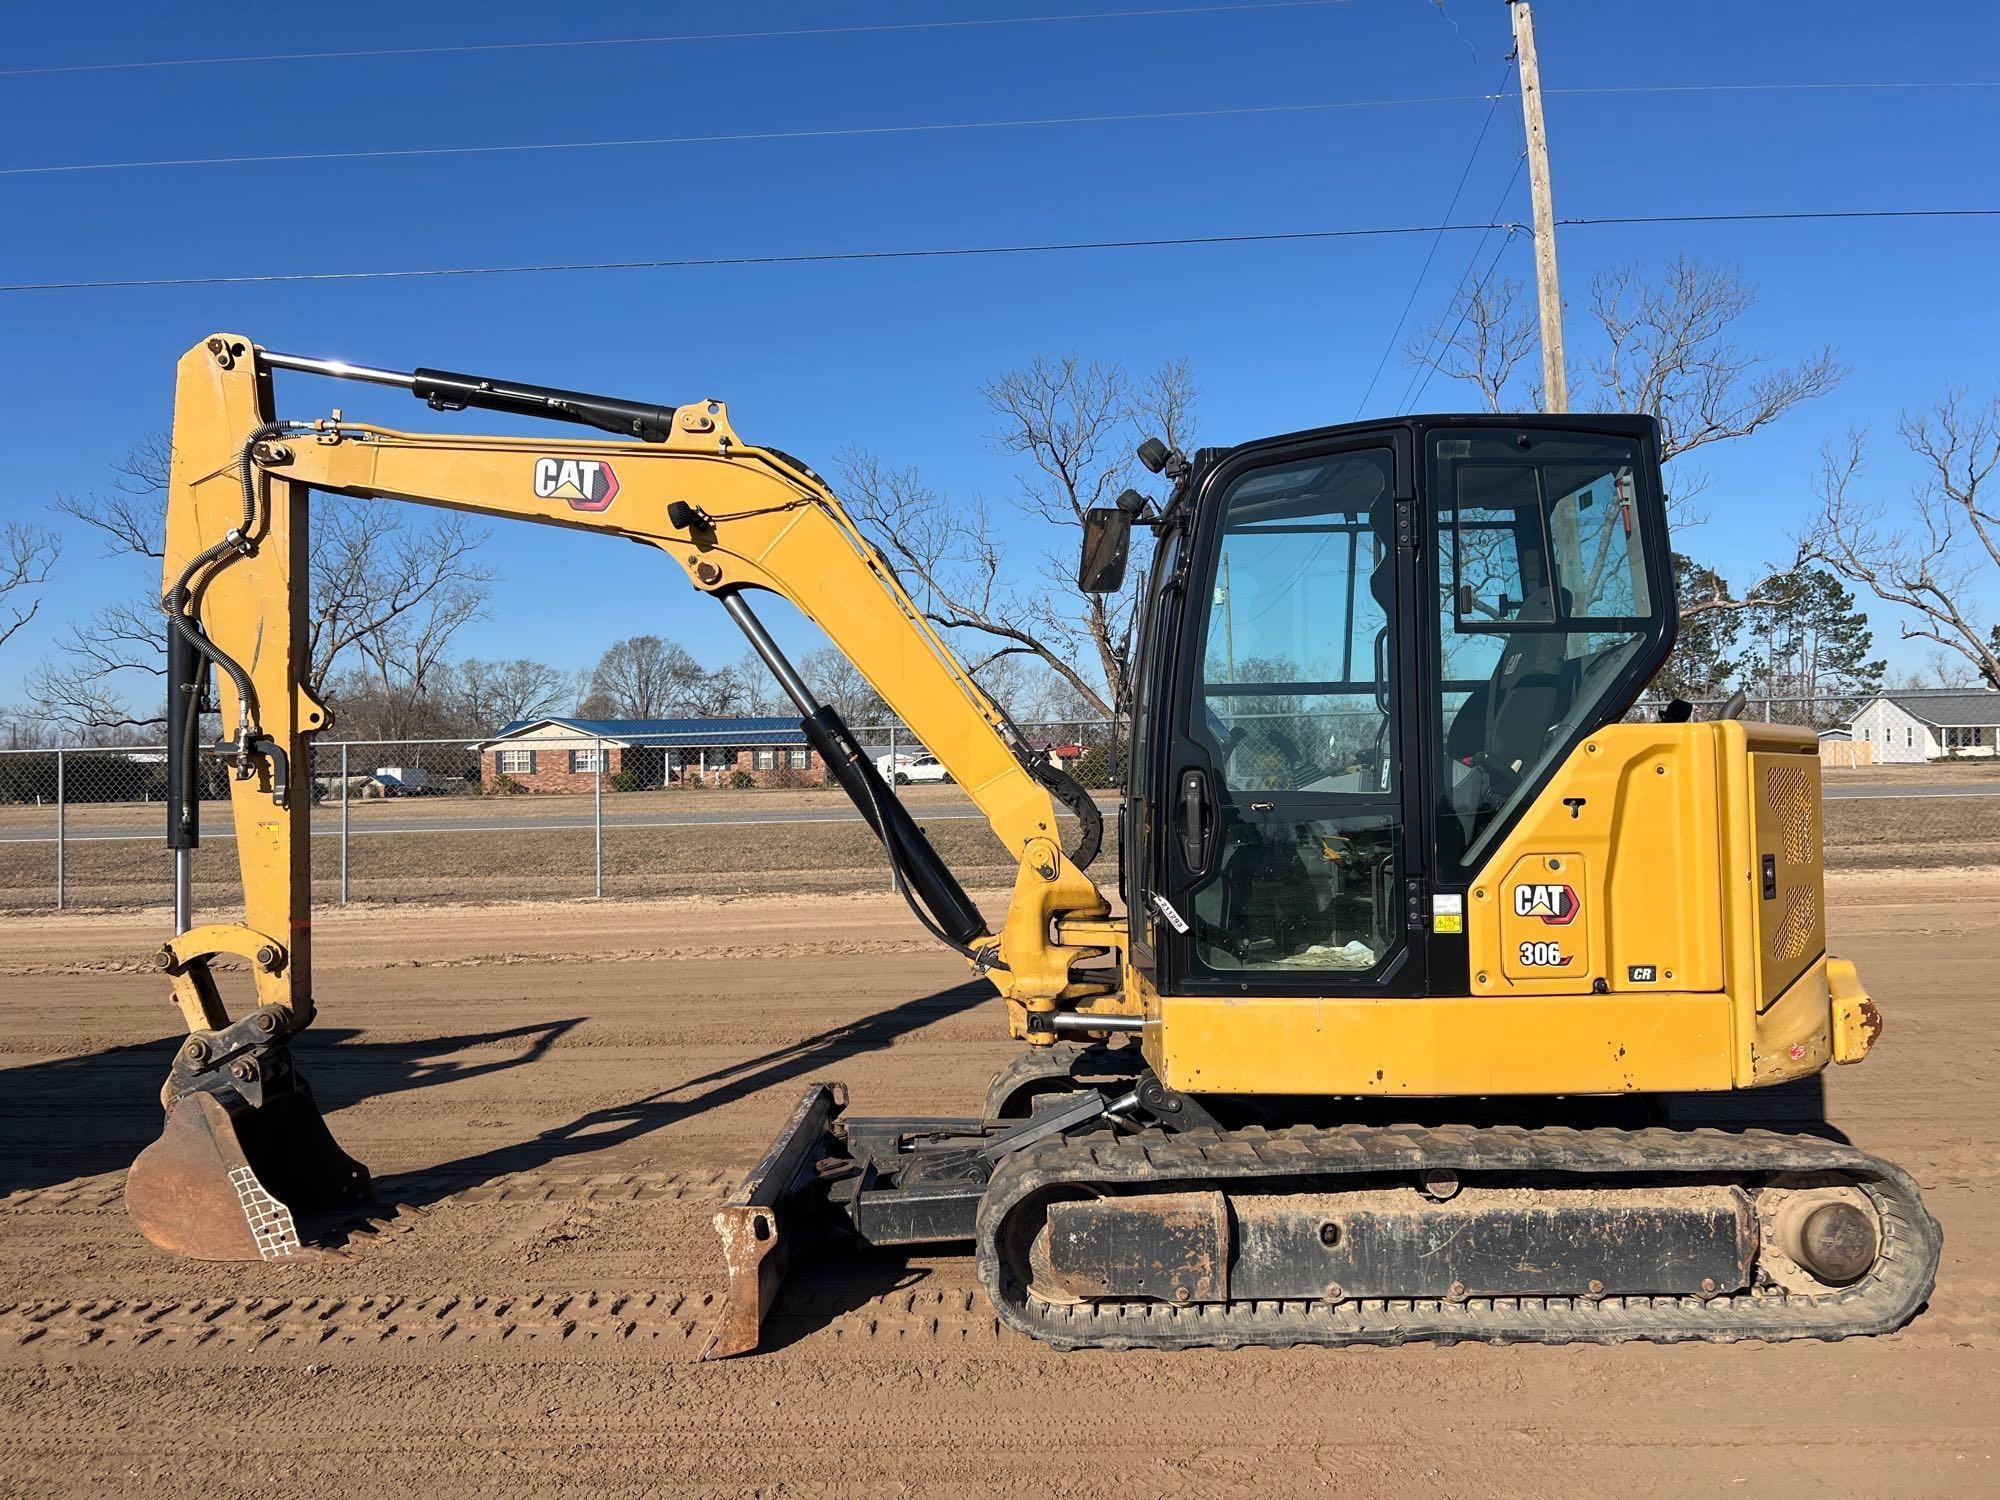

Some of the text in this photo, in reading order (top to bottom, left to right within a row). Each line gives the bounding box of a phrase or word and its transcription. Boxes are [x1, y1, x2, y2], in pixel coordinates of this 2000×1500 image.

[534, 458, 600, 500] CAT
[1515, 885, 1564, 916] CAT
[1520, 942, 1561, 966] 306
[1633, 968, 1652, 980] CR
